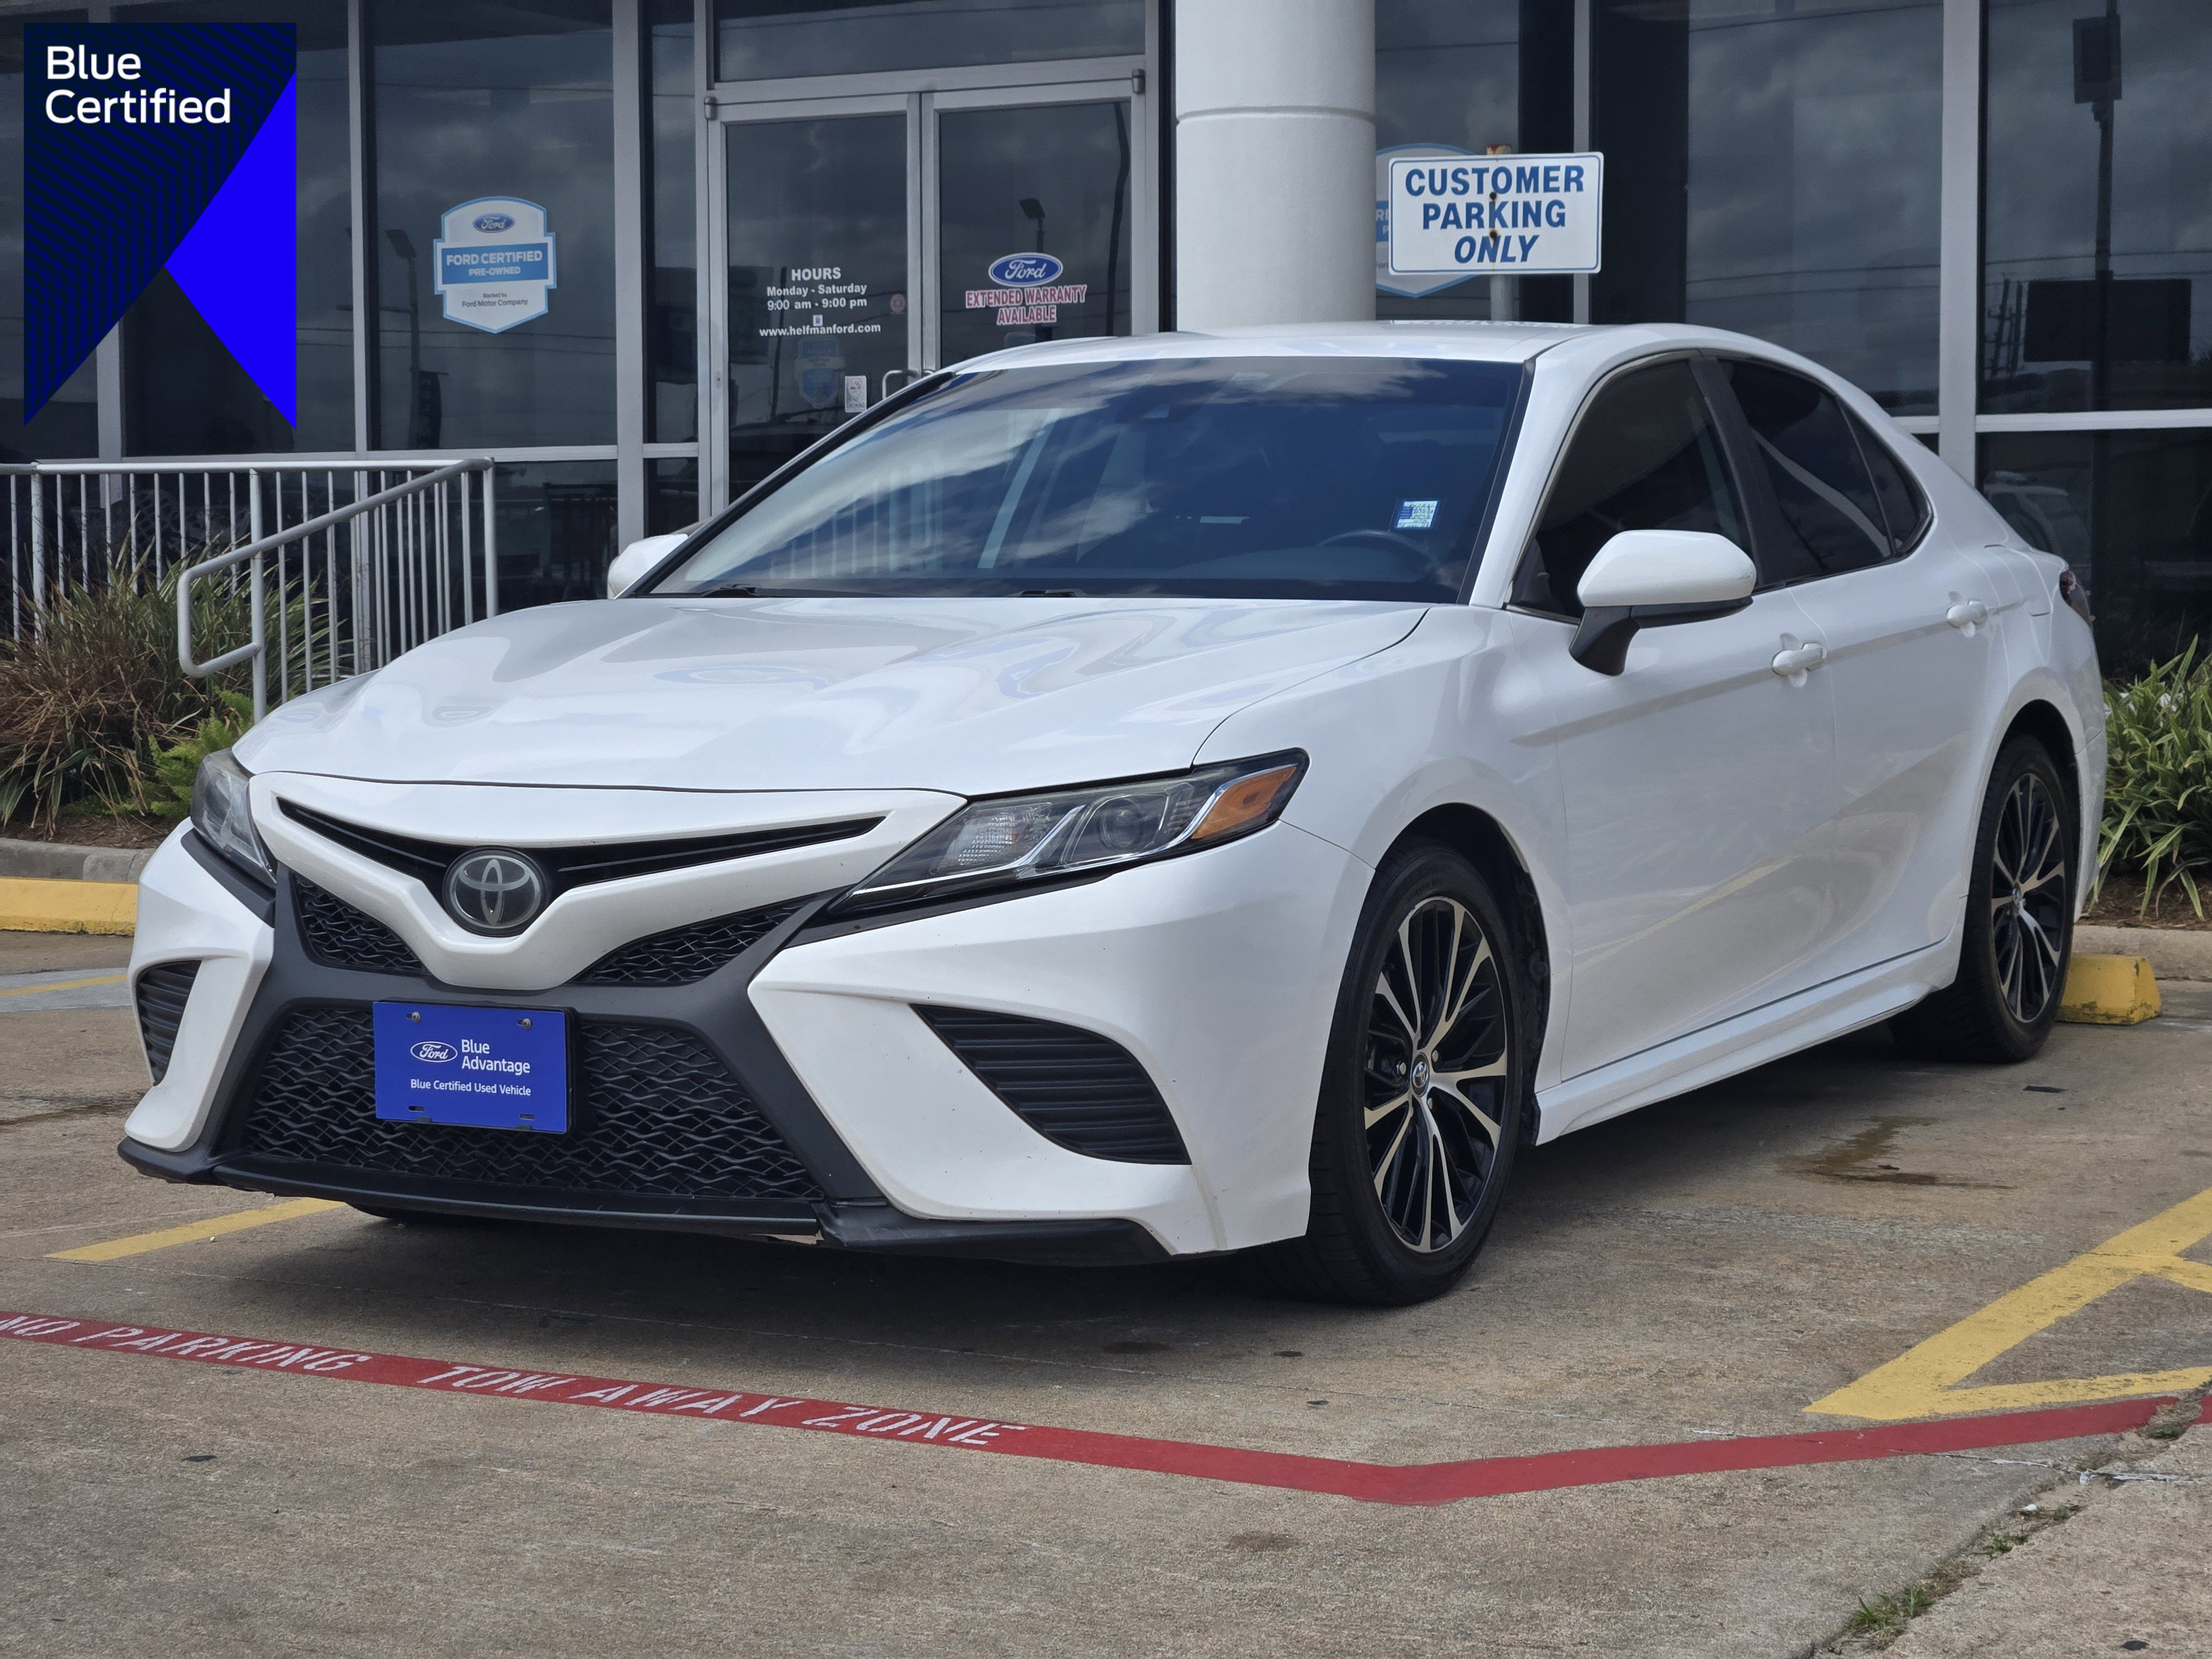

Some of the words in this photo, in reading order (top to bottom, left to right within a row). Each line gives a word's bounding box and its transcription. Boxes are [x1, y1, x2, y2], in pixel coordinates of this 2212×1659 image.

[1405, 165, 1584, 196] CUSTOMER
[481, 216, 507, 229] Ford
[1423, 200, 1566, 230] PARKING
[1454, 234, 1540, 264] ONLY
[446, 253, 479, 266] FORD
[481, 250, 543, 264] CERTIFIED
[468, 266, 521, 276] PRE-OWNED
[791, 267, 841, 281] HOURS
[1005, 259, 1047, 279] Ford
[767, 286, 808, 297] Monday
[818, 283, 867, 295] Saturday
[967, 289, 1022, 307] EXTENDED
[1025, 286, 1087, 305] WARRANTY
[498, 298, 528, 306] Company
[767, 299, 790, 310] 9:00
[794, 301, 812, 309] am
[822, 298, 846, 307] 9:00
[849, 299, 867, 309] pm
[998, 306, 1056, 324] AVAILABLE
[759, 324, 881, 336] www.helfmanford.com
[419, 1044, 449, 1060] Ford
[461, 1039, 490, 1054] Blue
[461, 1056, 531, 1076] Advantage
[410, 1079, 431, 1089] Blue
[433, 1080, 471, 1092] Certified
[474, 1082, 497, 1094] Used
[499, 1084, 531, 1096] Vehicle
[69, 1327, 373, 1371] PARKING
[416, 1365, 577, 1394] TOW
[566, 1384, 805, 1417] AWAY
[801, 1406, 1029, 1445] ZONE
